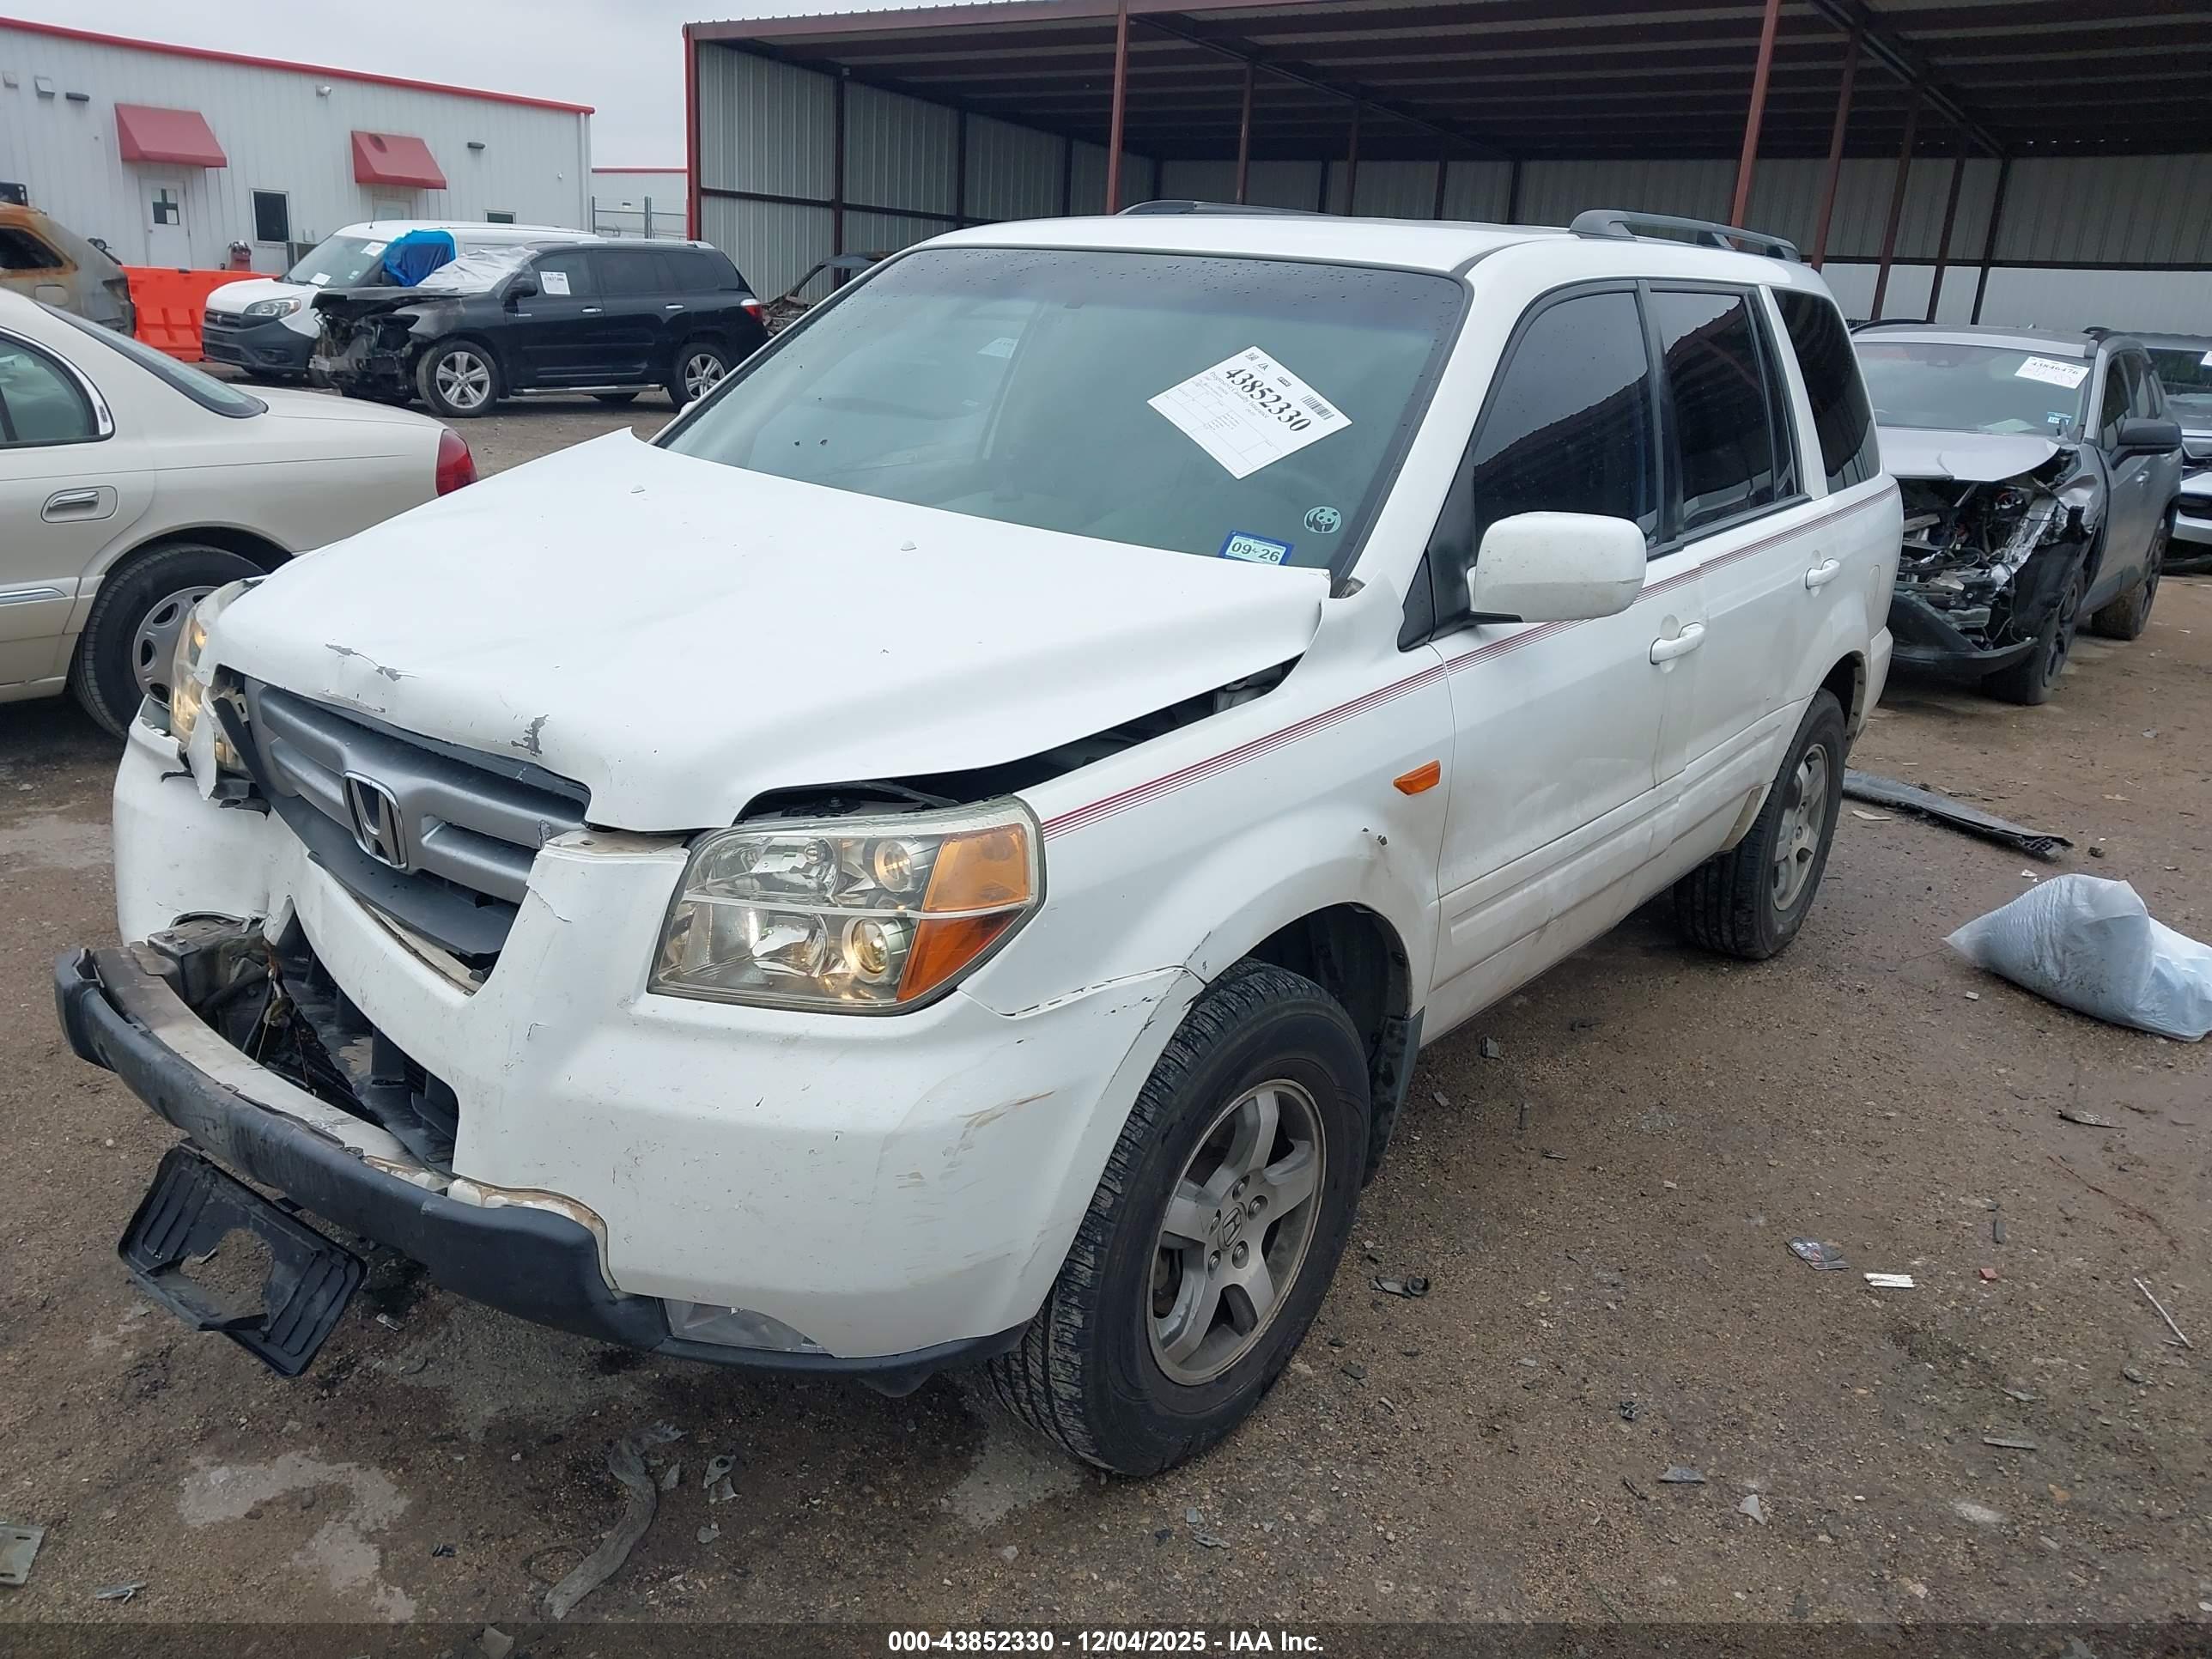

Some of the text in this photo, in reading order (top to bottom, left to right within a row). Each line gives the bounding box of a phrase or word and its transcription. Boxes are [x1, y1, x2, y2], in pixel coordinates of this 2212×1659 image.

[1225, 368, 1312, 432] 43852330
[1231, 542, 1252, 555] 09
[1258, 549, 1280, 562] 26
